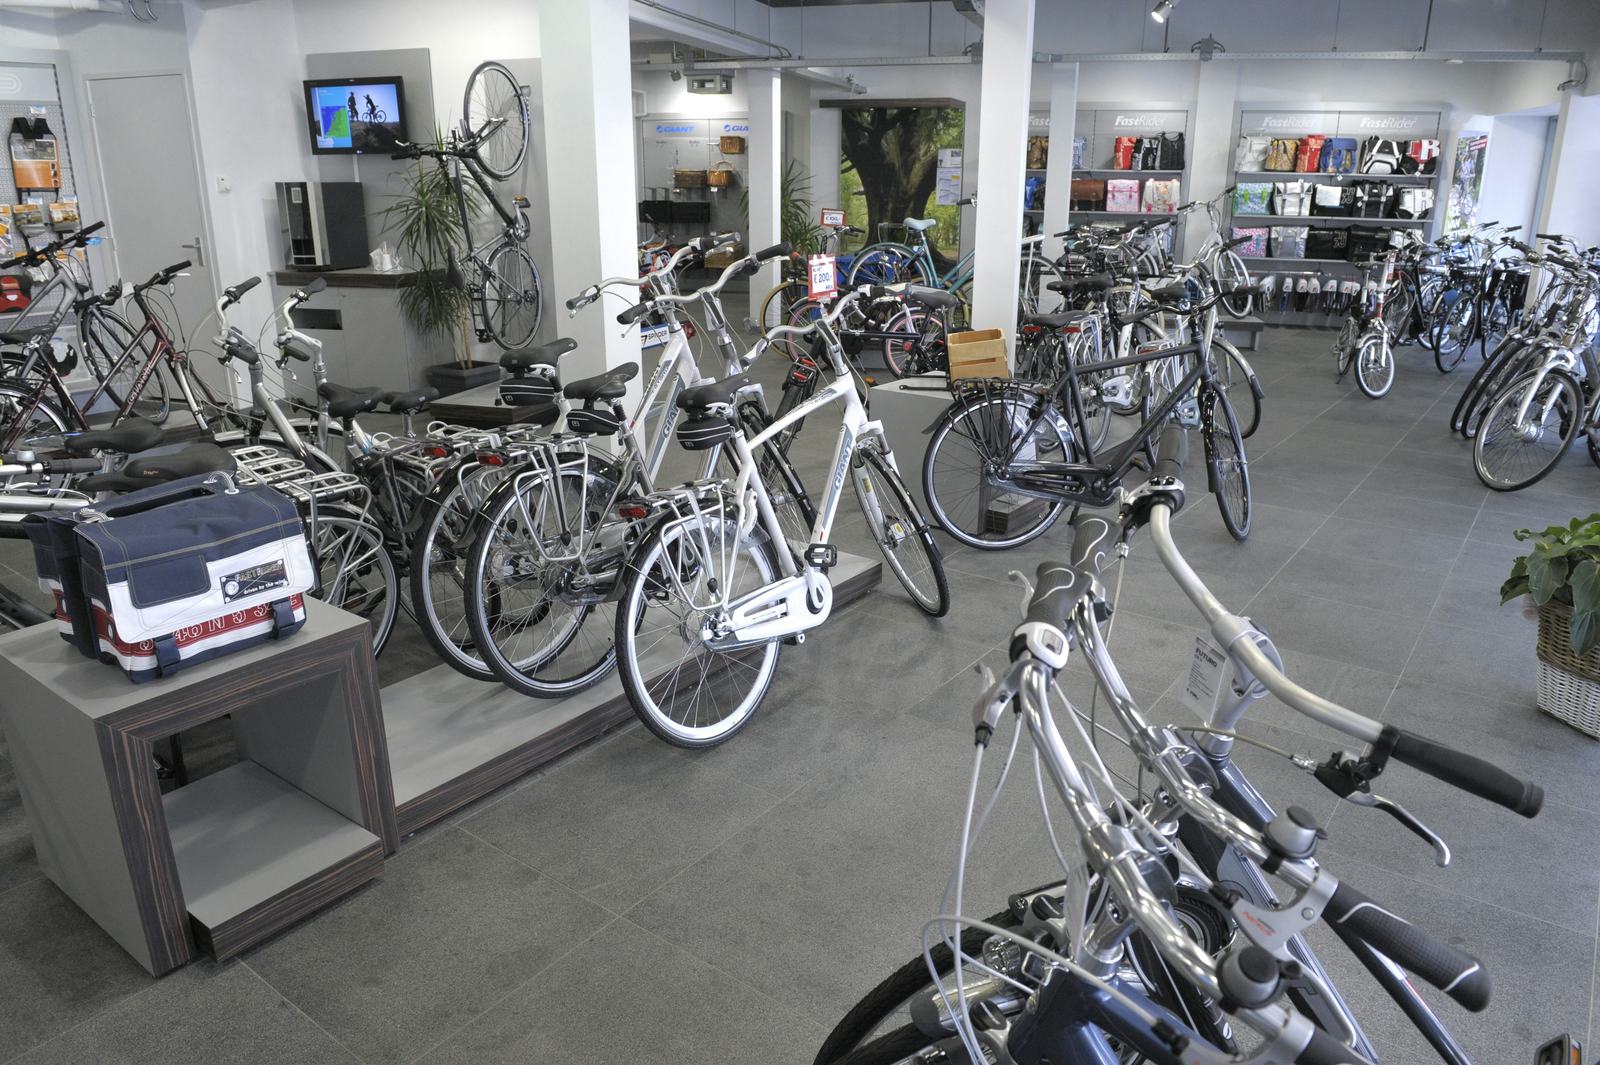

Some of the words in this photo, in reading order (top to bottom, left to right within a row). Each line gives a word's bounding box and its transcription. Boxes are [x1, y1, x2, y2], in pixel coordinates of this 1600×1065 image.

[1115, 115, 1166, 127] FastRider
[1262, 116, 1316, 128] FastRider
[1360, 117, 1416, 129] FastRider
[813, 273, 818, 284] €
[832, 438, 853, 492] GIANT
[1195, 647, 1218, 668] FUTURO
